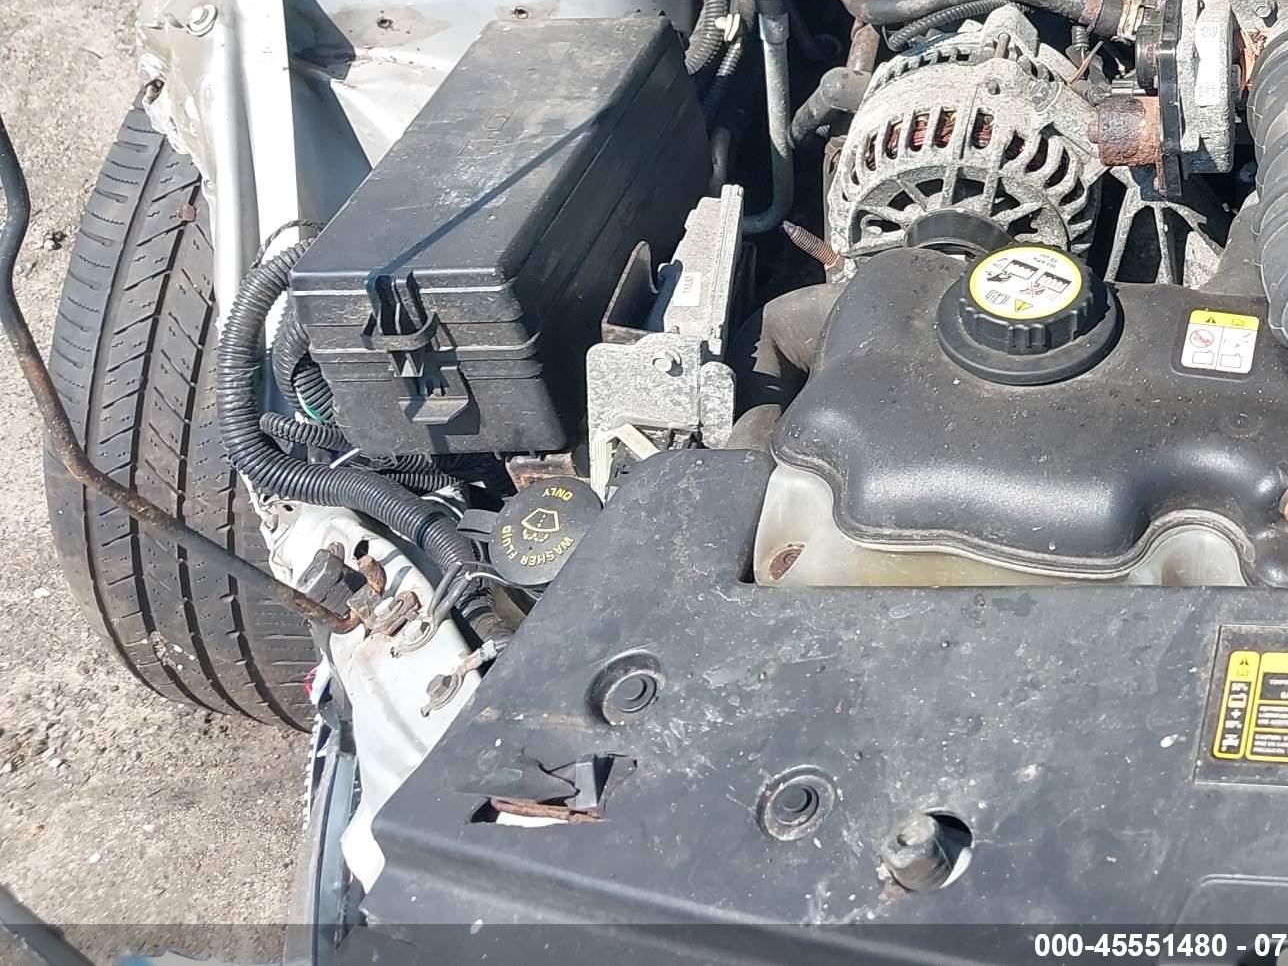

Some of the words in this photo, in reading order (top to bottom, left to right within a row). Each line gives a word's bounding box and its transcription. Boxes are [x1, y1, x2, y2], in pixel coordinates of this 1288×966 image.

[542, 486, 574, 502] ONLY
[501, 525, 519, 561] FLUID
[520, 536, 574, 566] WASHER
